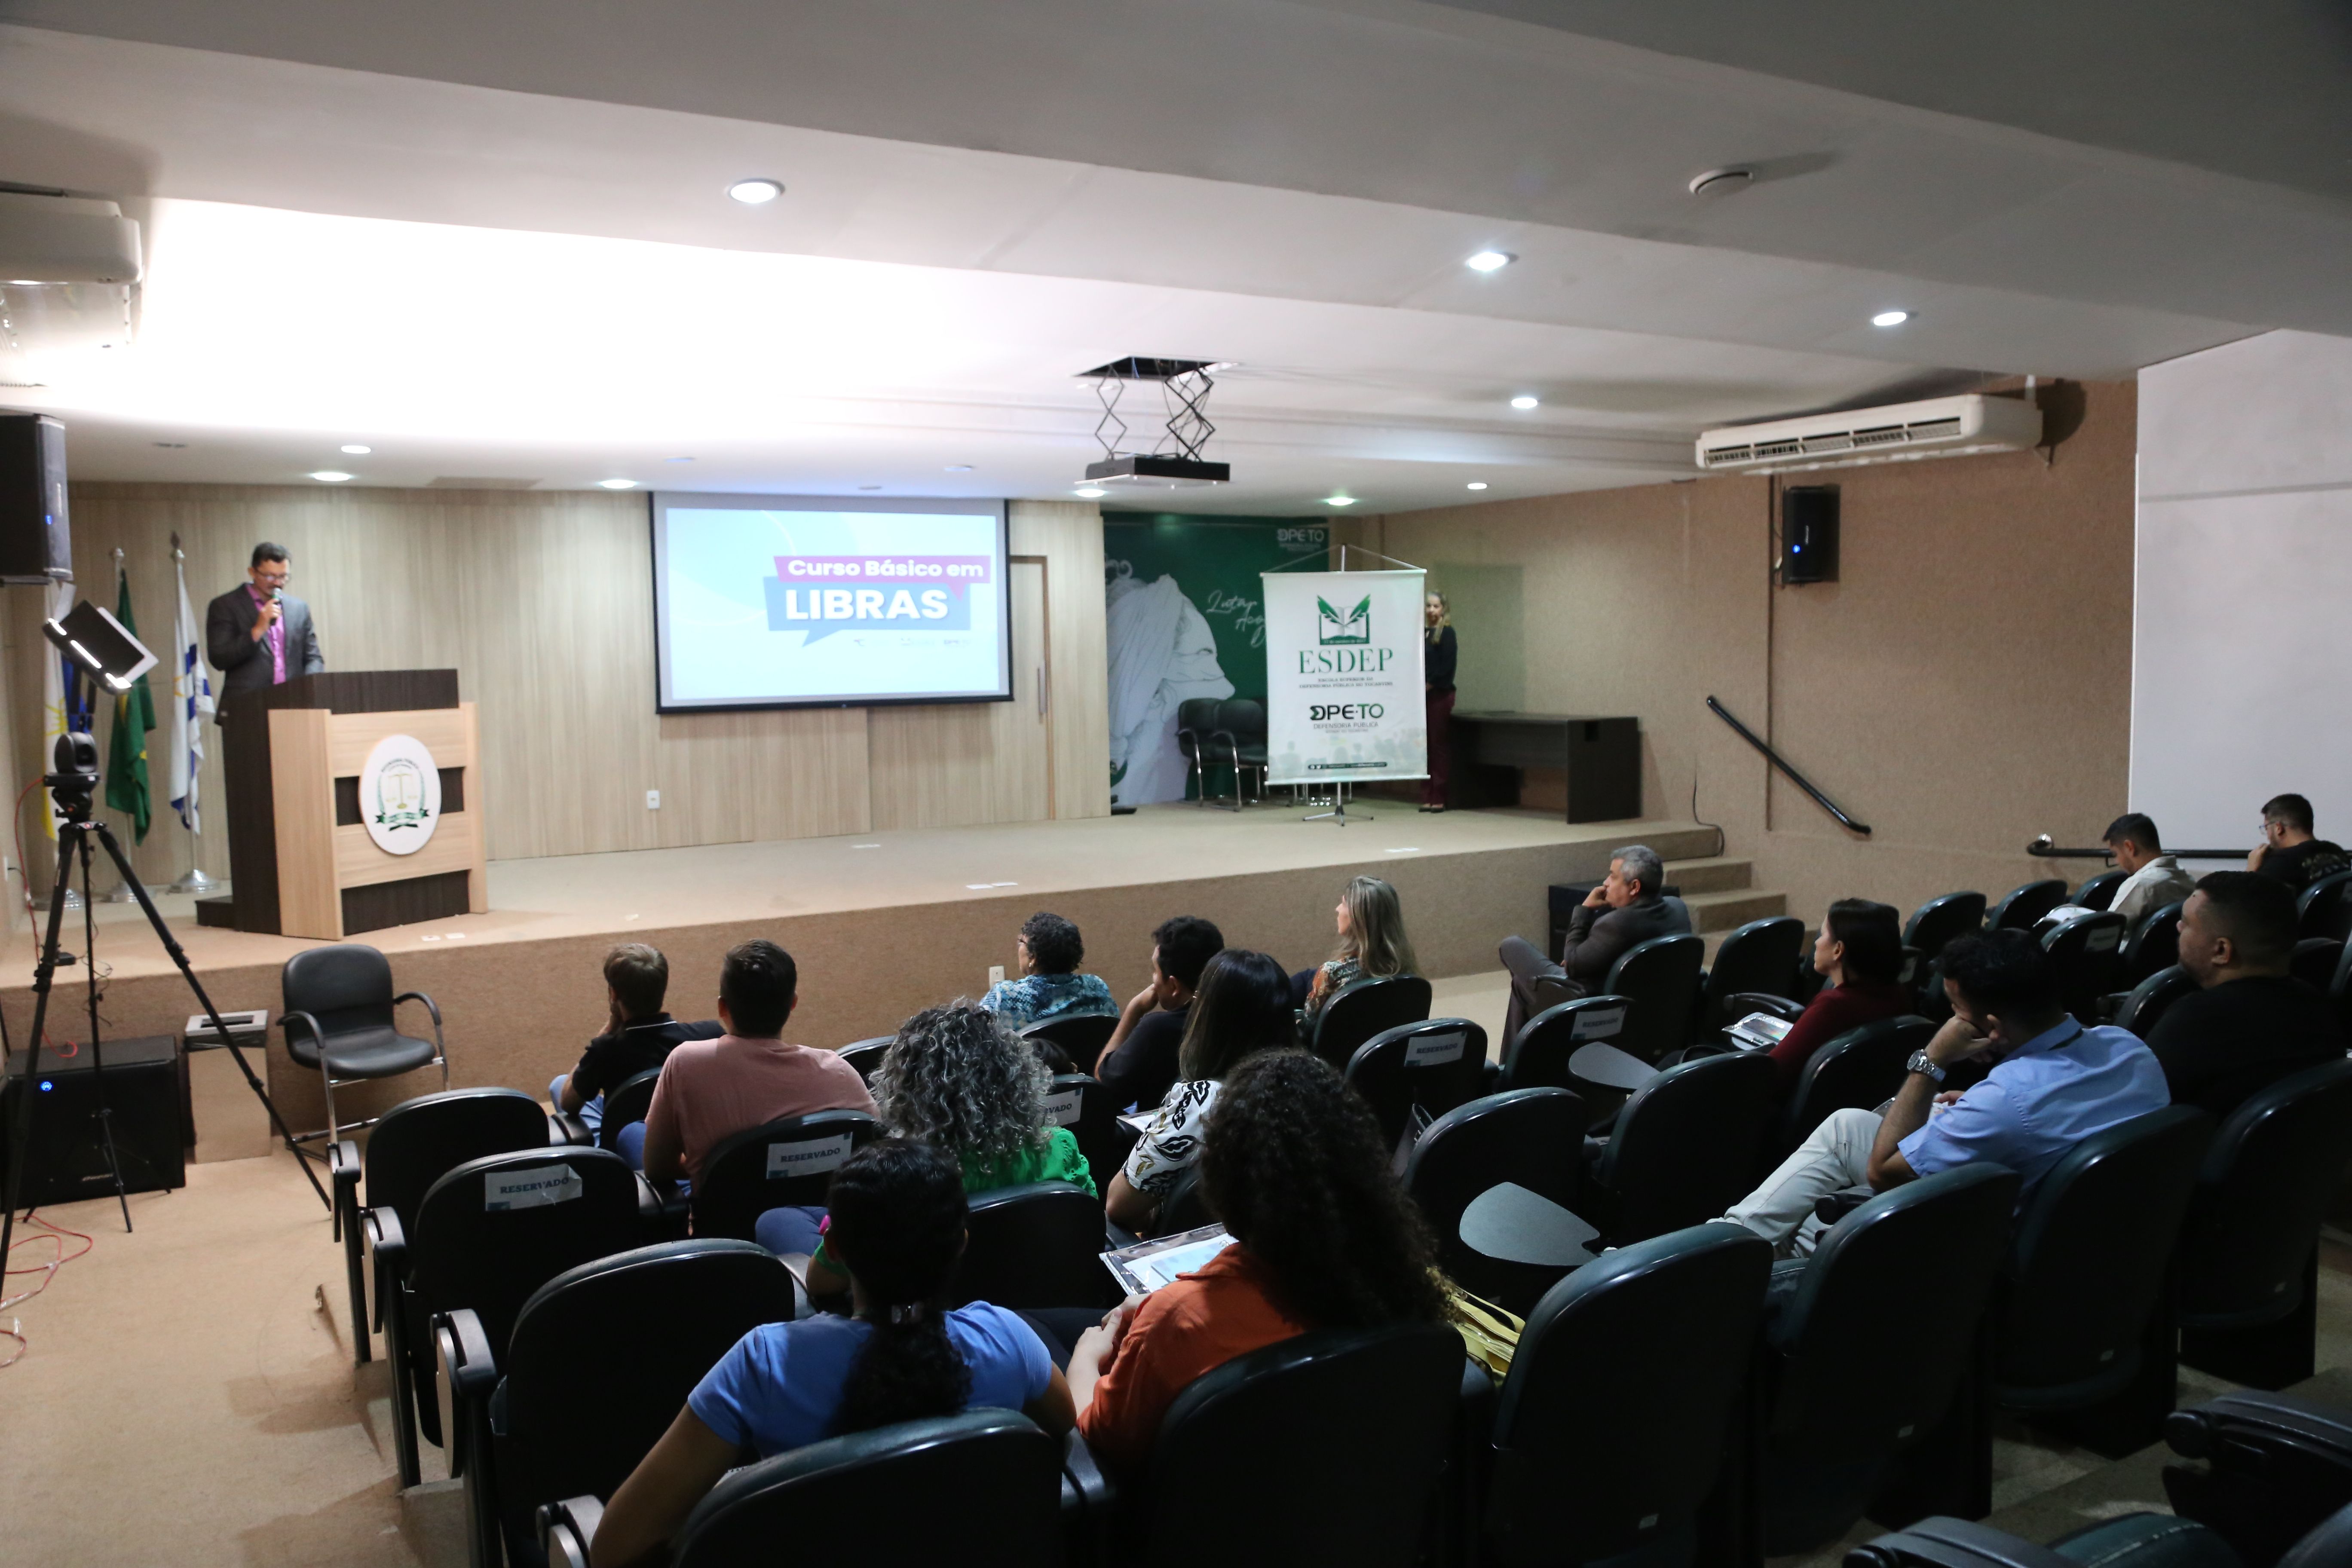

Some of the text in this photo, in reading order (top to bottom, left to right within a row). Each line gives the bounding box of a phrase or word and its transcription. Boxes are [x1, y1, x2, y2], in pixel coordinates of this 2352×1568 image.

[788, 559, 984, 577] Curso Básico em
[786, 588, 949, 620] LIBRAS
[1299, 647, 1393, 674] ESDEP
[1416, 1043, 1458, 1054] RESERVADO
[780, 1148, 841, 1162] RESERVADO
[500, 1177, 569, 1194] RESERVADO
